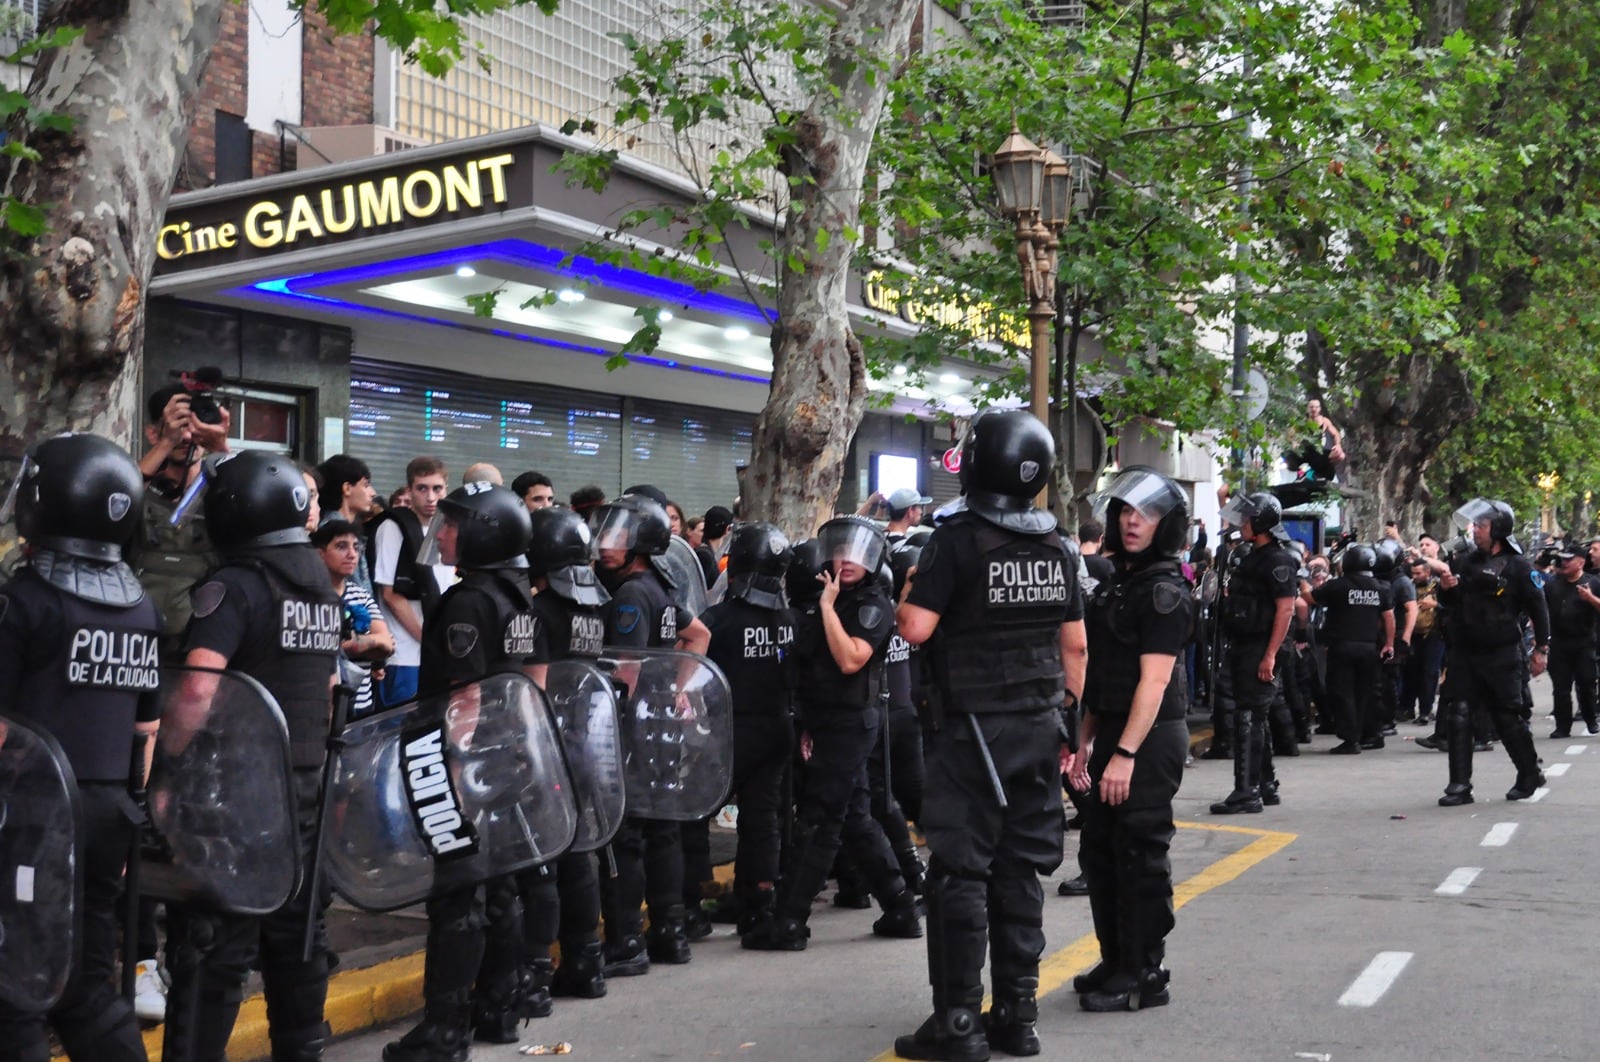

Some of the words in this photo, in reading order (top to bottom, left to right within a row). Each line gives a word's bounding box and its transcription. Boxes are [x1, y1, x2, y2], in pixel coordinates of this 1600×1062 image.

[156, 221, 237, 260] Cine
[244, 153, 515, 249] GAUMONT
[988, 560, 1065, 587] POLICIA
[988, 587, 1006, 603] DE
[1008, 587, 1025, 603] LA
[1026, 586, 1066, 603] CIUDAD
[1348, 589, 1380, 600] POLICIA
[283, 600, 341, 633] POLICIA
[71, 628, 159, 668] POLICIA
[282, 629, 298, 648] DE
[299, 631, 312, 649] LA
[744, 625, 794, 646] POLCIA
[744, 646, 757, 658] DE
[759, 646, 770, 658] LA
[69, 661, 91, 683] DE
[93, 665, 113, 685] LA
[116, 666, 160, 689] CIUDAD
[405, 728, 473, 855] POLICIA
